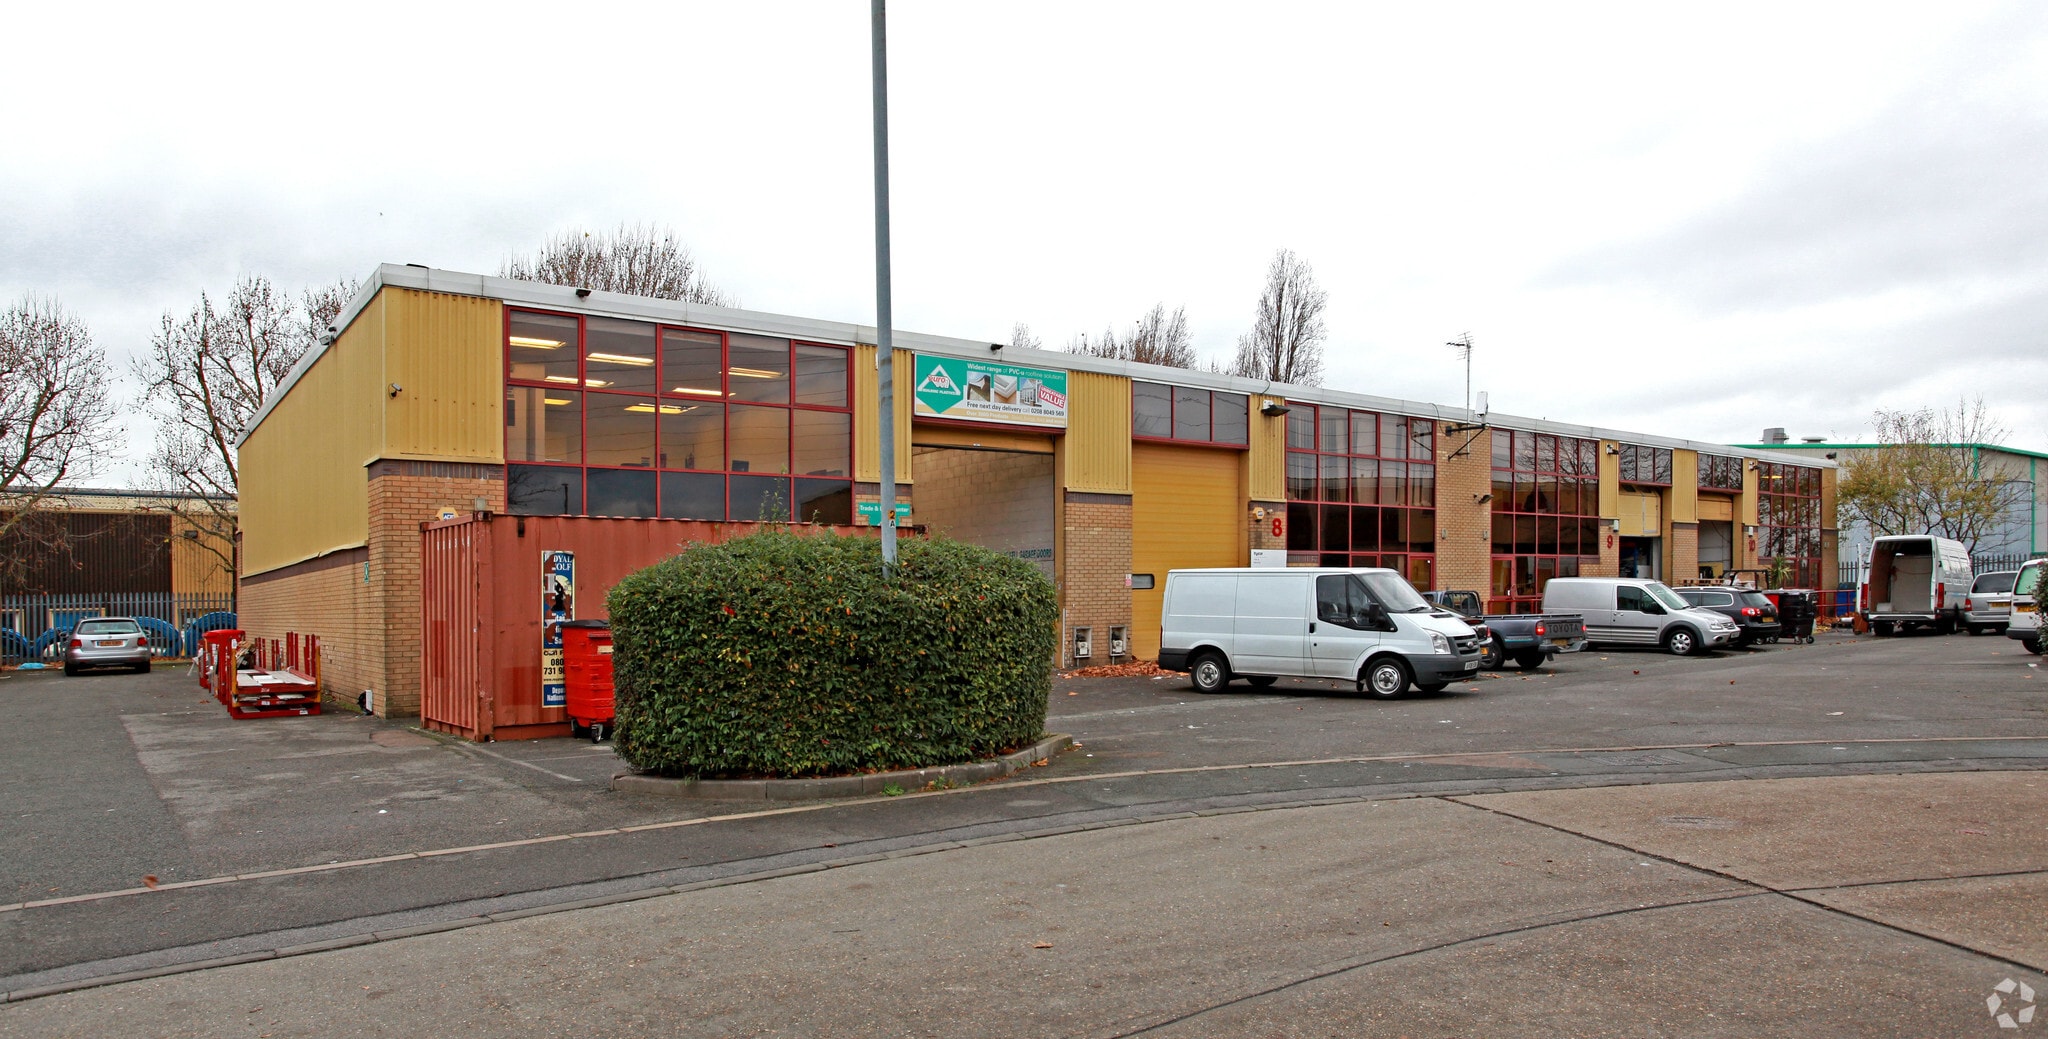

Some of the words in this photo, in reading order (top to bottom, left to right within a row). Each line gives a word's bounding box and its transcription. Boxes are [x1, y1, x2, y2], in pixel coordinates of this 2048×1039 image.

[967, 363, 986, 371] Widest
[986, 366, 1002, 374] range
[1008, 368, 1025, 376] PVC-u
[1043, 372, 1064, 380] solutions
[1040, 391, 1064, 407] VALUE
[991, 404, 1001, 412] day
[1002, 405, 1022, 413] delivery
[889, 510, 895, 519] 2
[890, 520, 895, 528] A
[1271, 517, 1283, 538] 8
[1606, 534, 1613, 549] 9
[1748, 539, 1756, 552] 10
[555, 563, 571, 571] OLF
[1548, 624, 1579, 634] TOYOTA
[543, 667, 556, 675] 731
